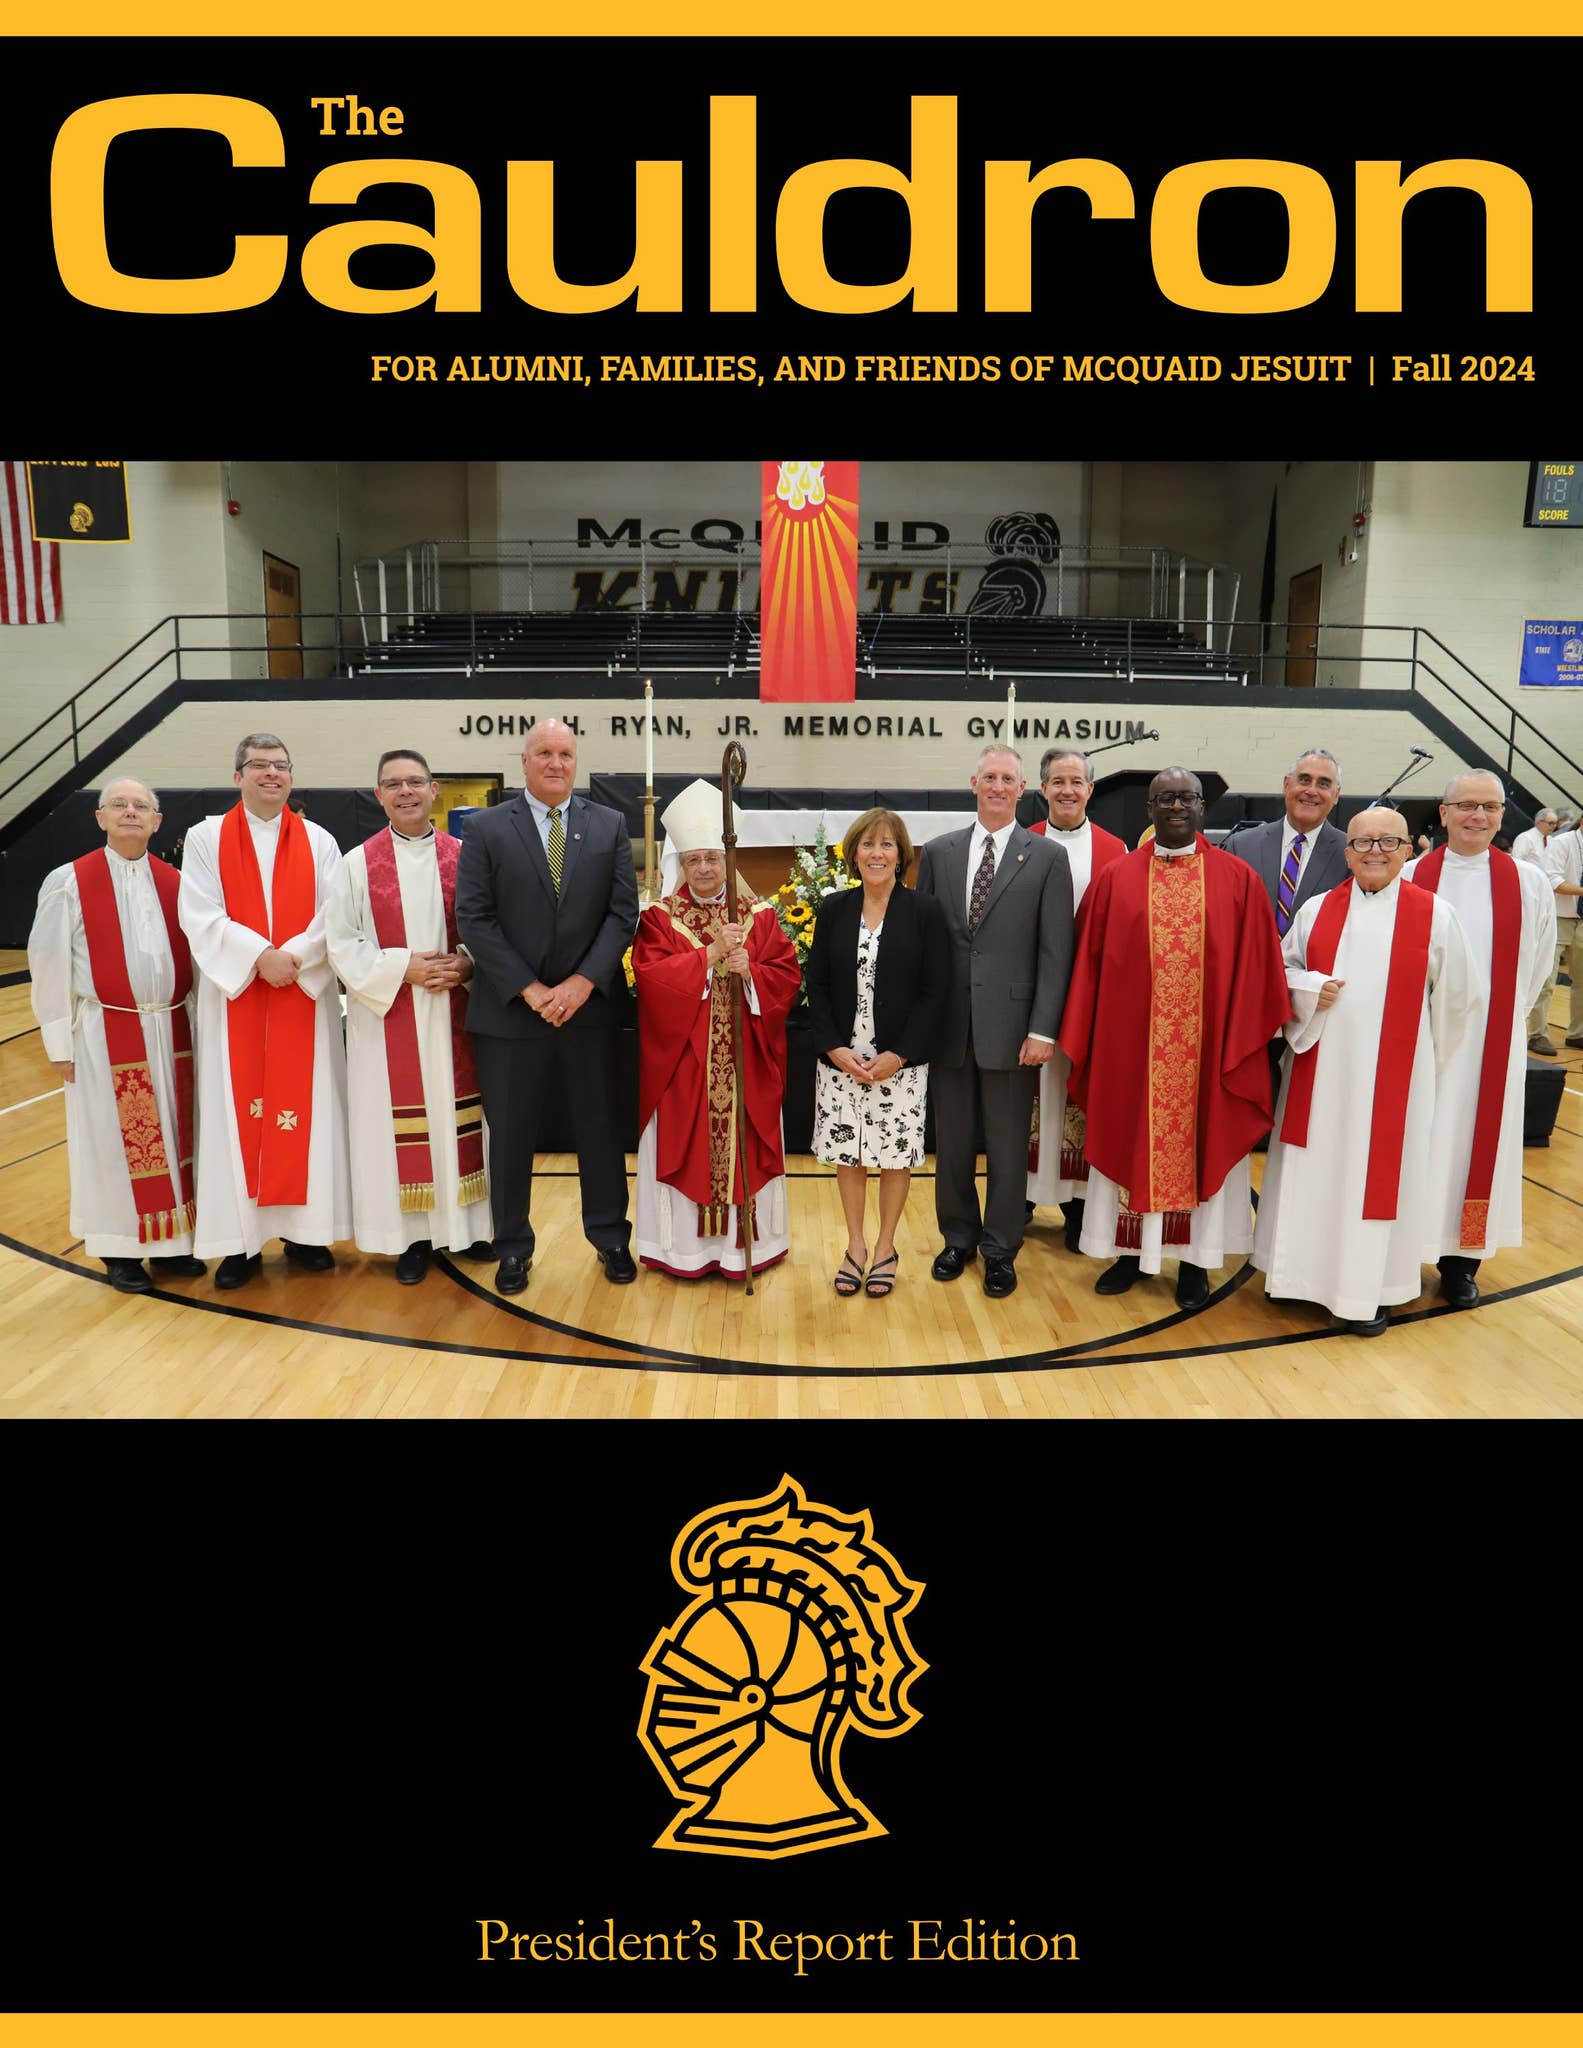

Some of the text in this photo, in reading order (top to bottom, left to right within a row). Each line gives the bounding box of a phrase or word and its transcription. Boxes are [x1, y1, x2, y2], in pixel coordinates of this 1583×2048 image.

[1544, 464, 1575, 476] FOULS
[1545, 478, 1568, 503] 18
[1538, 509, 1569, 521] SCORE
[576, 518, 951, 554] McQID
[571, 568, 962, 614] KNITS
[1527, 624, 1577, 636] SCHOLAR
[459, 715, 1145, 741] JOHN H. RYAN, JR. MEMORIAL GYMNASIUM
